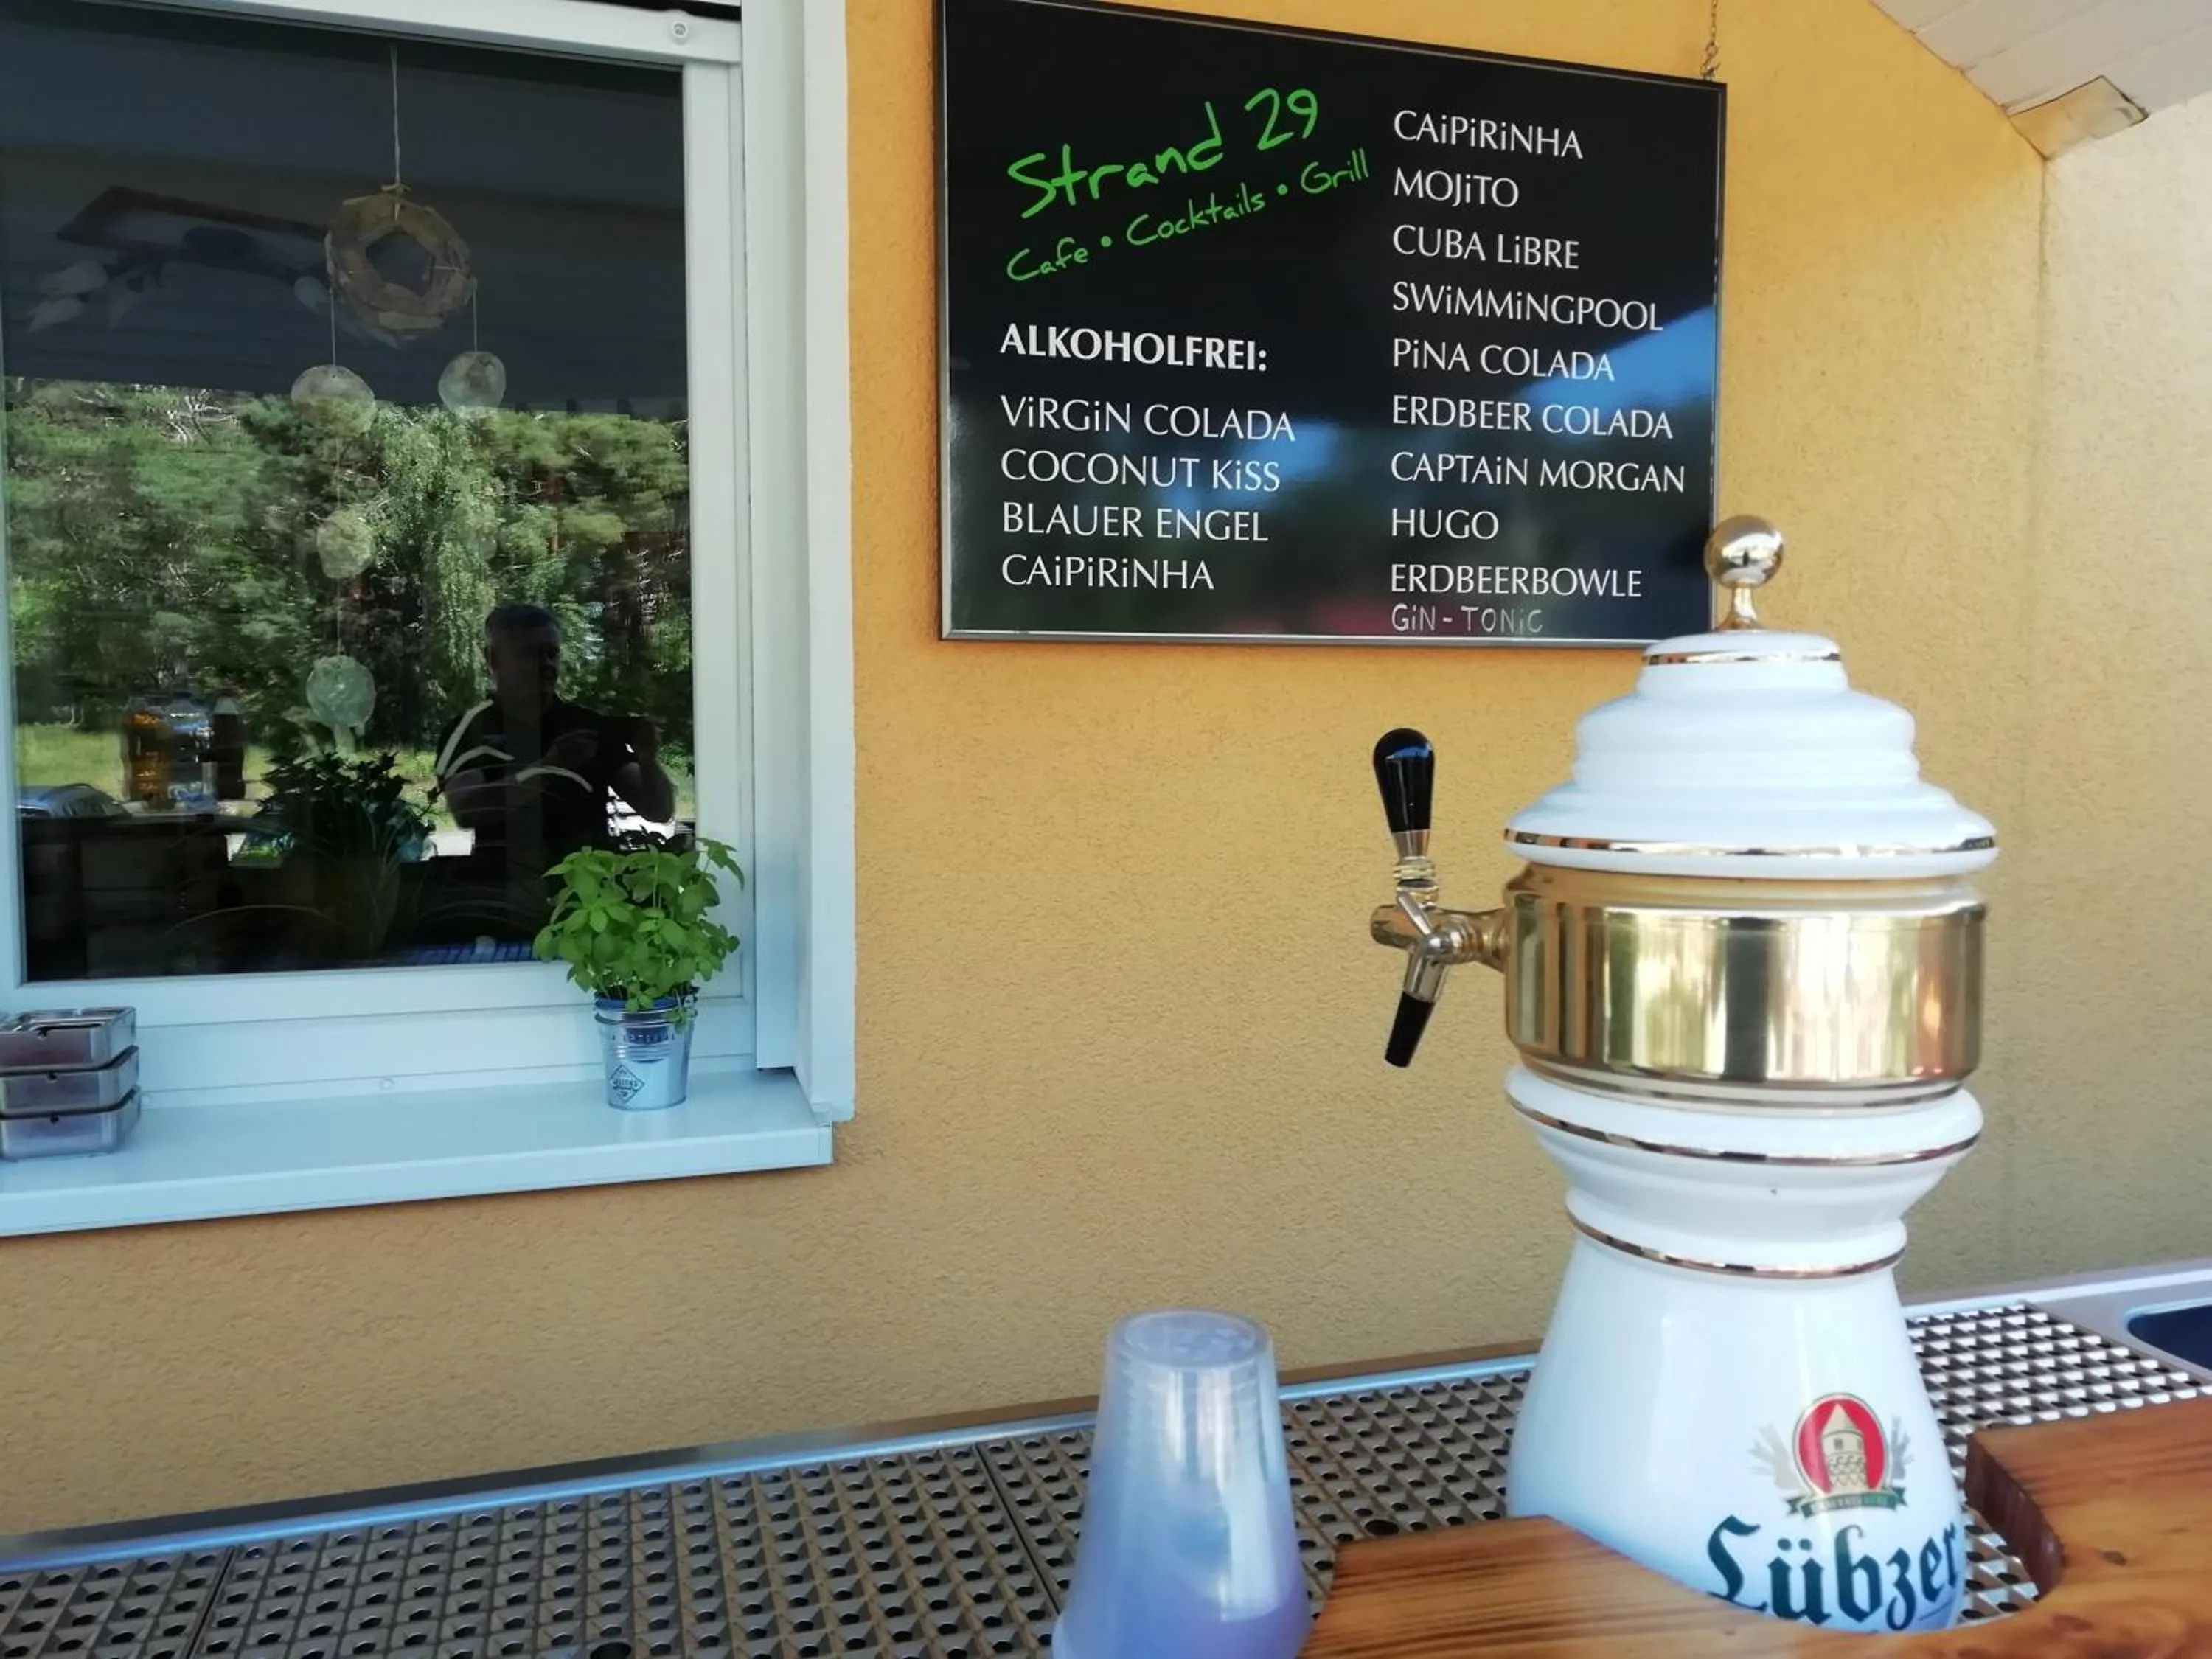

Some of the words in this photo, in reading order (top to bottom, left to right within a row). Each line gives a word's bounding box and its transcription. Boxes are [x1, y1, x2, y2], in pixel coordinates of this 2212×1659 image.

[1006, 100, 1225, 220] Strand
[1244, 87, 1319, 152] 29
[1394, 110, 1584, 159] CAiPiRiNHA
[1394, 167, 1519, 207] MOJiTO
[1006, 236, 1089, 282] Cafe
[1125, 181, 1267, 246] Cocktails
[1300, 147, 1370, 195] Grill
[1393, 224, 1486, 261] CUBA
[1498, 234, 1580, 270] LiBRE
[1393, 281, 1663, 331] SWiMMiNGPOOL
[1000, 323, 1267, 372] ALKOHOLFREI:
[1394, 338, 1471, 372] PiNA
[1480, 344, 1615, 381] COLADA
[1001, 395, 1131, 433] ViRGiN
[1144, 404, 1296, 442] COLADA
[1393, 394, 1532, 431] ERDBEER
[1542, 404, 1674, 439] COLADA
[1001, 448, 1200, 488] COCONUT
[1213, 460, 1280, 492] KiSS
[1391, 451, 1528, 486] CAPTAiN
[1540, 459, 1685, 493] MORGAN
[1004, 502, 1144, 538] BLAUER
[1157, 508, 1269, 541] ENGEL
[1391, 508, 1500, 540] HUGO
[1002, 554, 1215, 590] CAiPiRiNHA
[1391, 563, 1643, 597] ERDBEERBOWLE
[1391, 603, 1436, 633] GiN
[1461, 605, 1544, 635] TONiC
[1707, 1514, 1958, 1631] Lübzer
